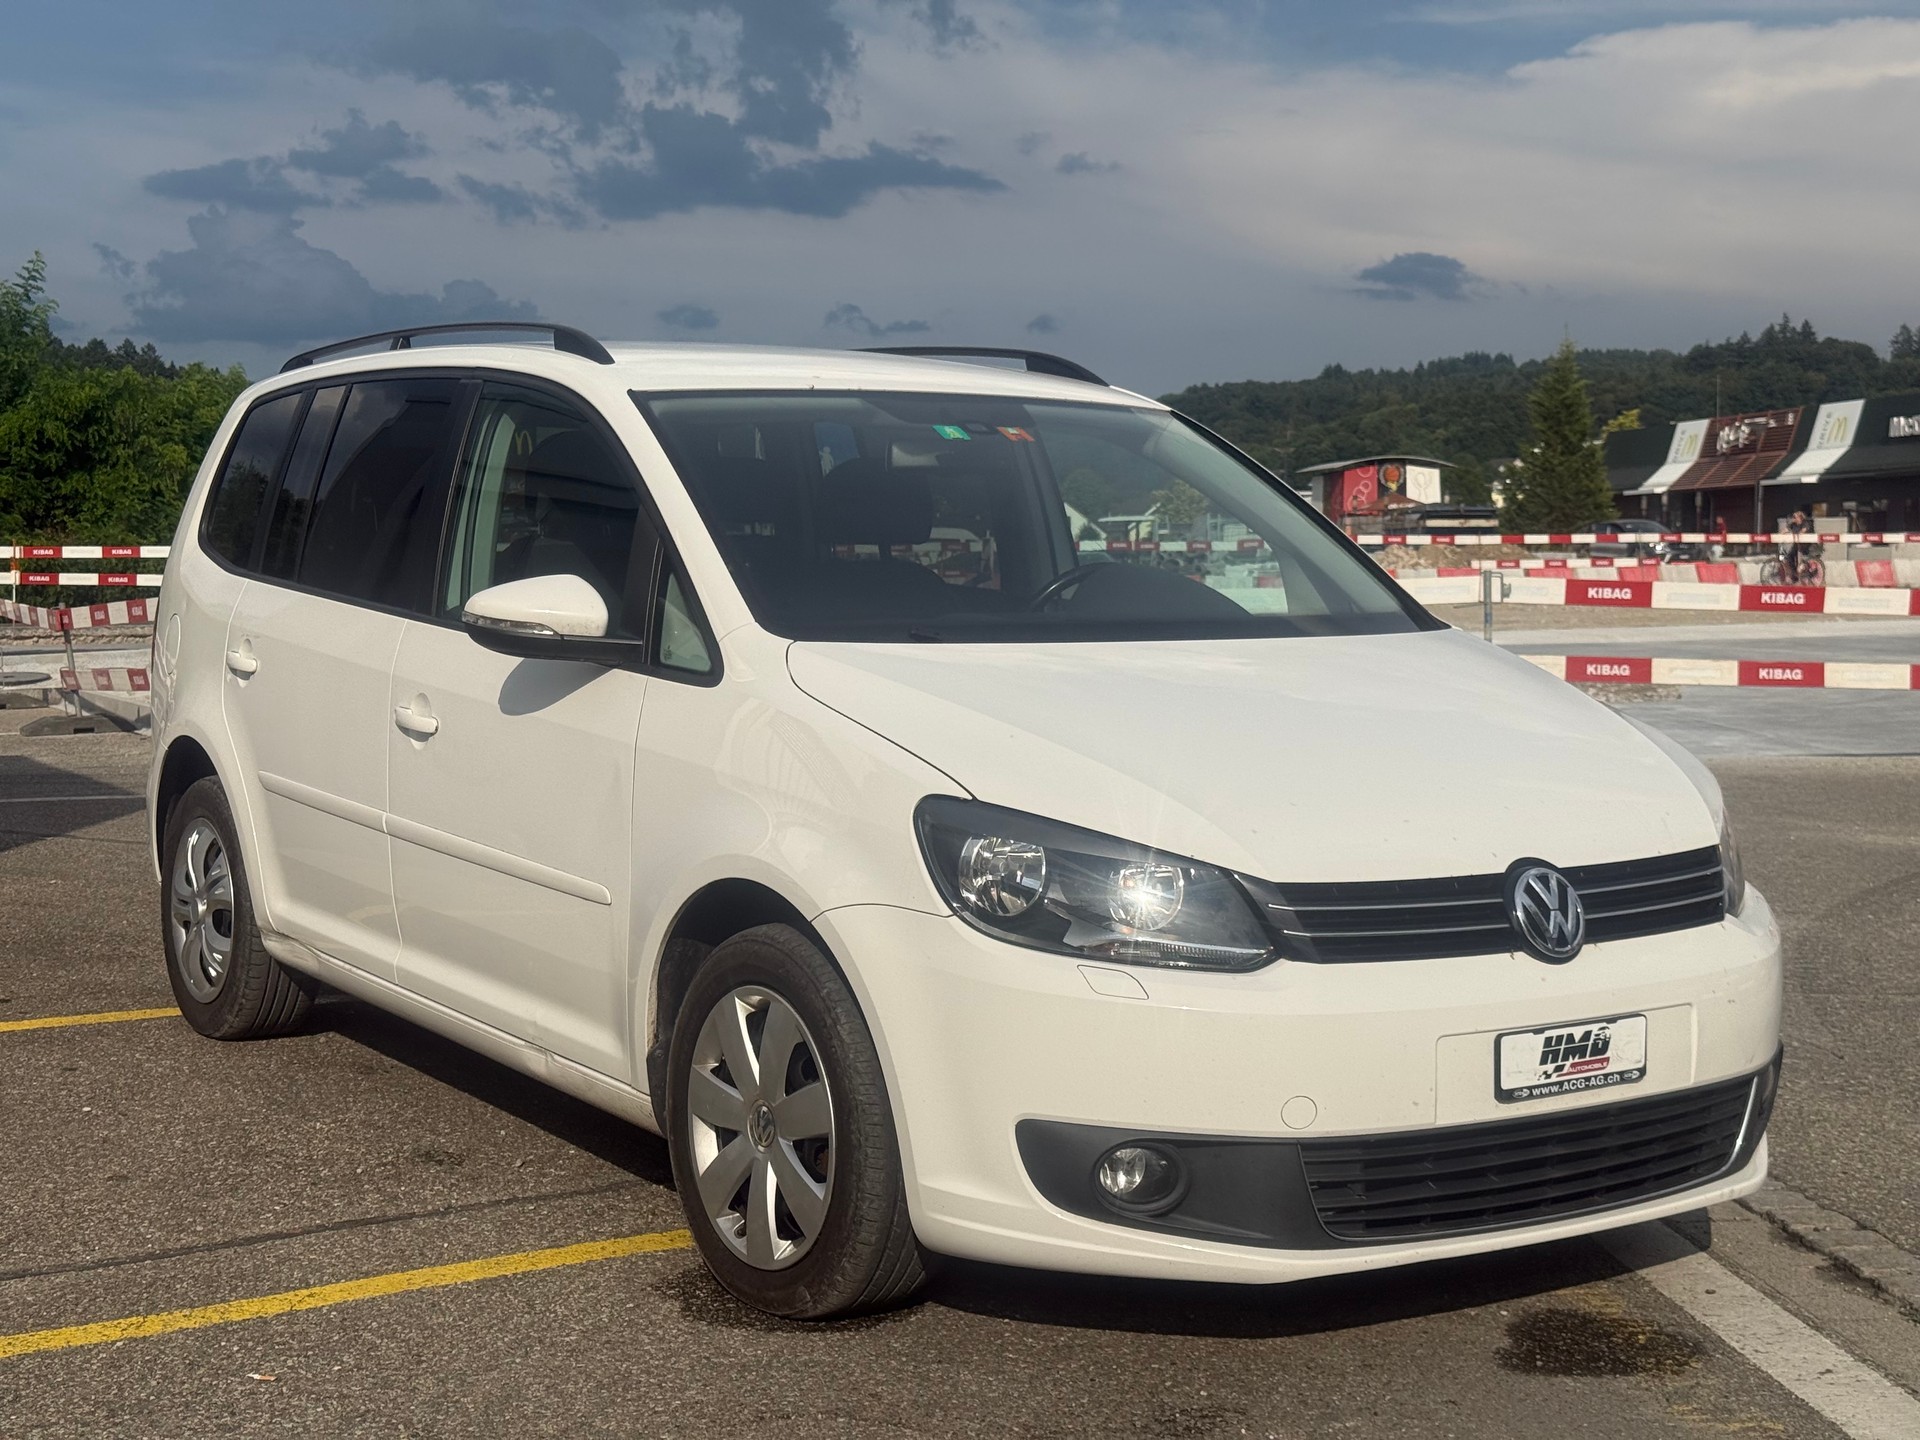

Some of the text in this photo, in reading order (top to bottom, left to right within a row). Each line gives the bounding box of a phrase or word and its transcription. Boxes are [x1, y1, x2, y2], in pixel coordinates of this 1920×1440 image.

[1587, 587, 1633, 600] KIBAG
[1761, 592, 1806, 605] KIBAG
[1586, 664, 1631, 676] KIBAG
[1759, 668, 1804, 680] KIBAG
[1539, 1026, 1612, 1066] HMD
[1568, 1061, 1609, 1073] AUTOMOBILE
[1532, 1074, 1621, 1097] www.ACG-AG.ch
